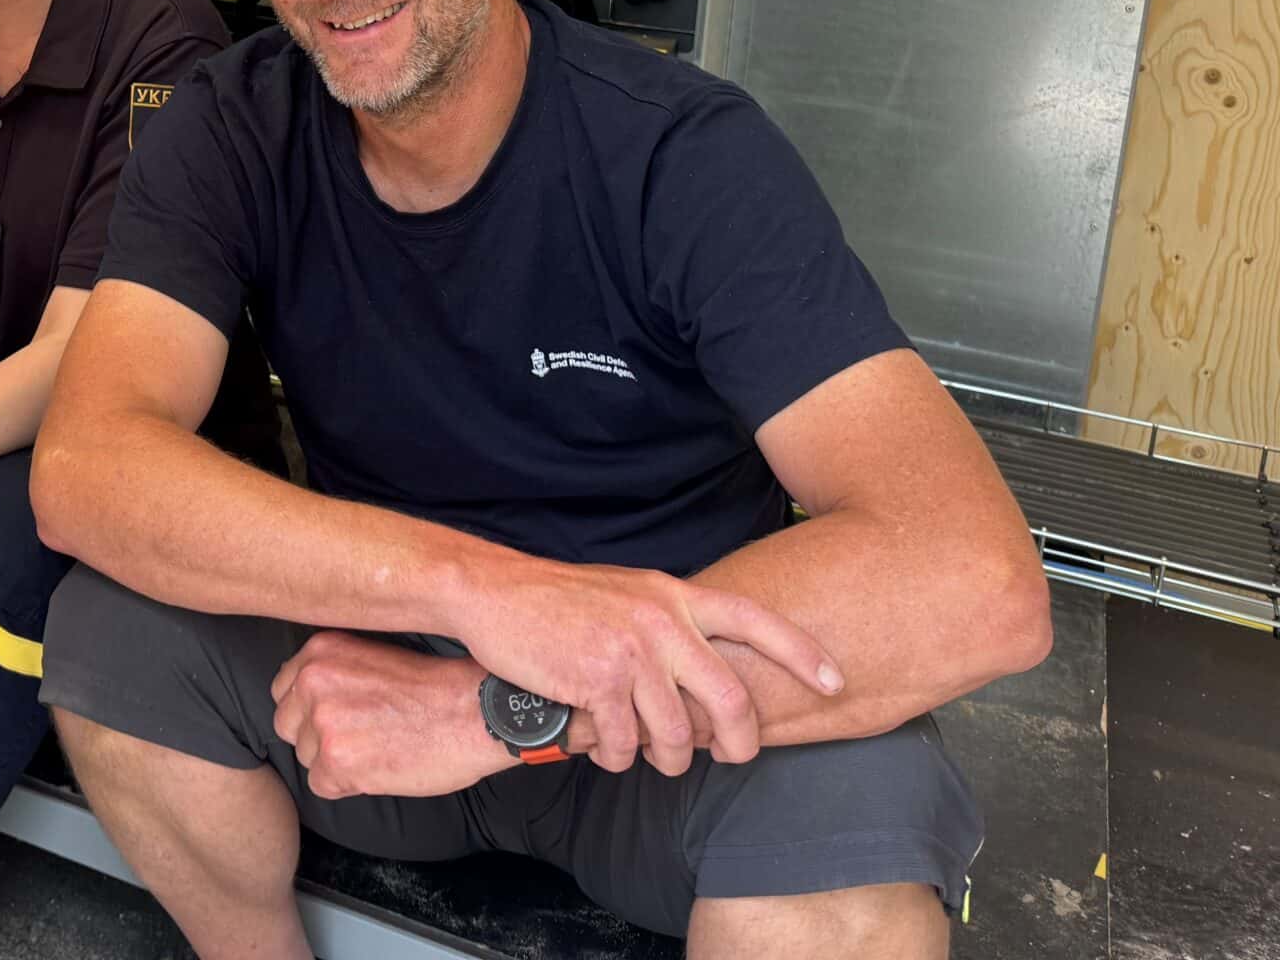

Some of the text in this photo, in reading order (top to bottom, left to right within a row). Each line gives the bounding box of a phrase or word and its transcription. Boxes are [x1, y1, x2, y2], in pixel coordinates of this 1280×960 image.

[548, 350, 587, 361] Swedish
[587, 352, 606, 364] Civil
[550, 360, 568, 370] and
